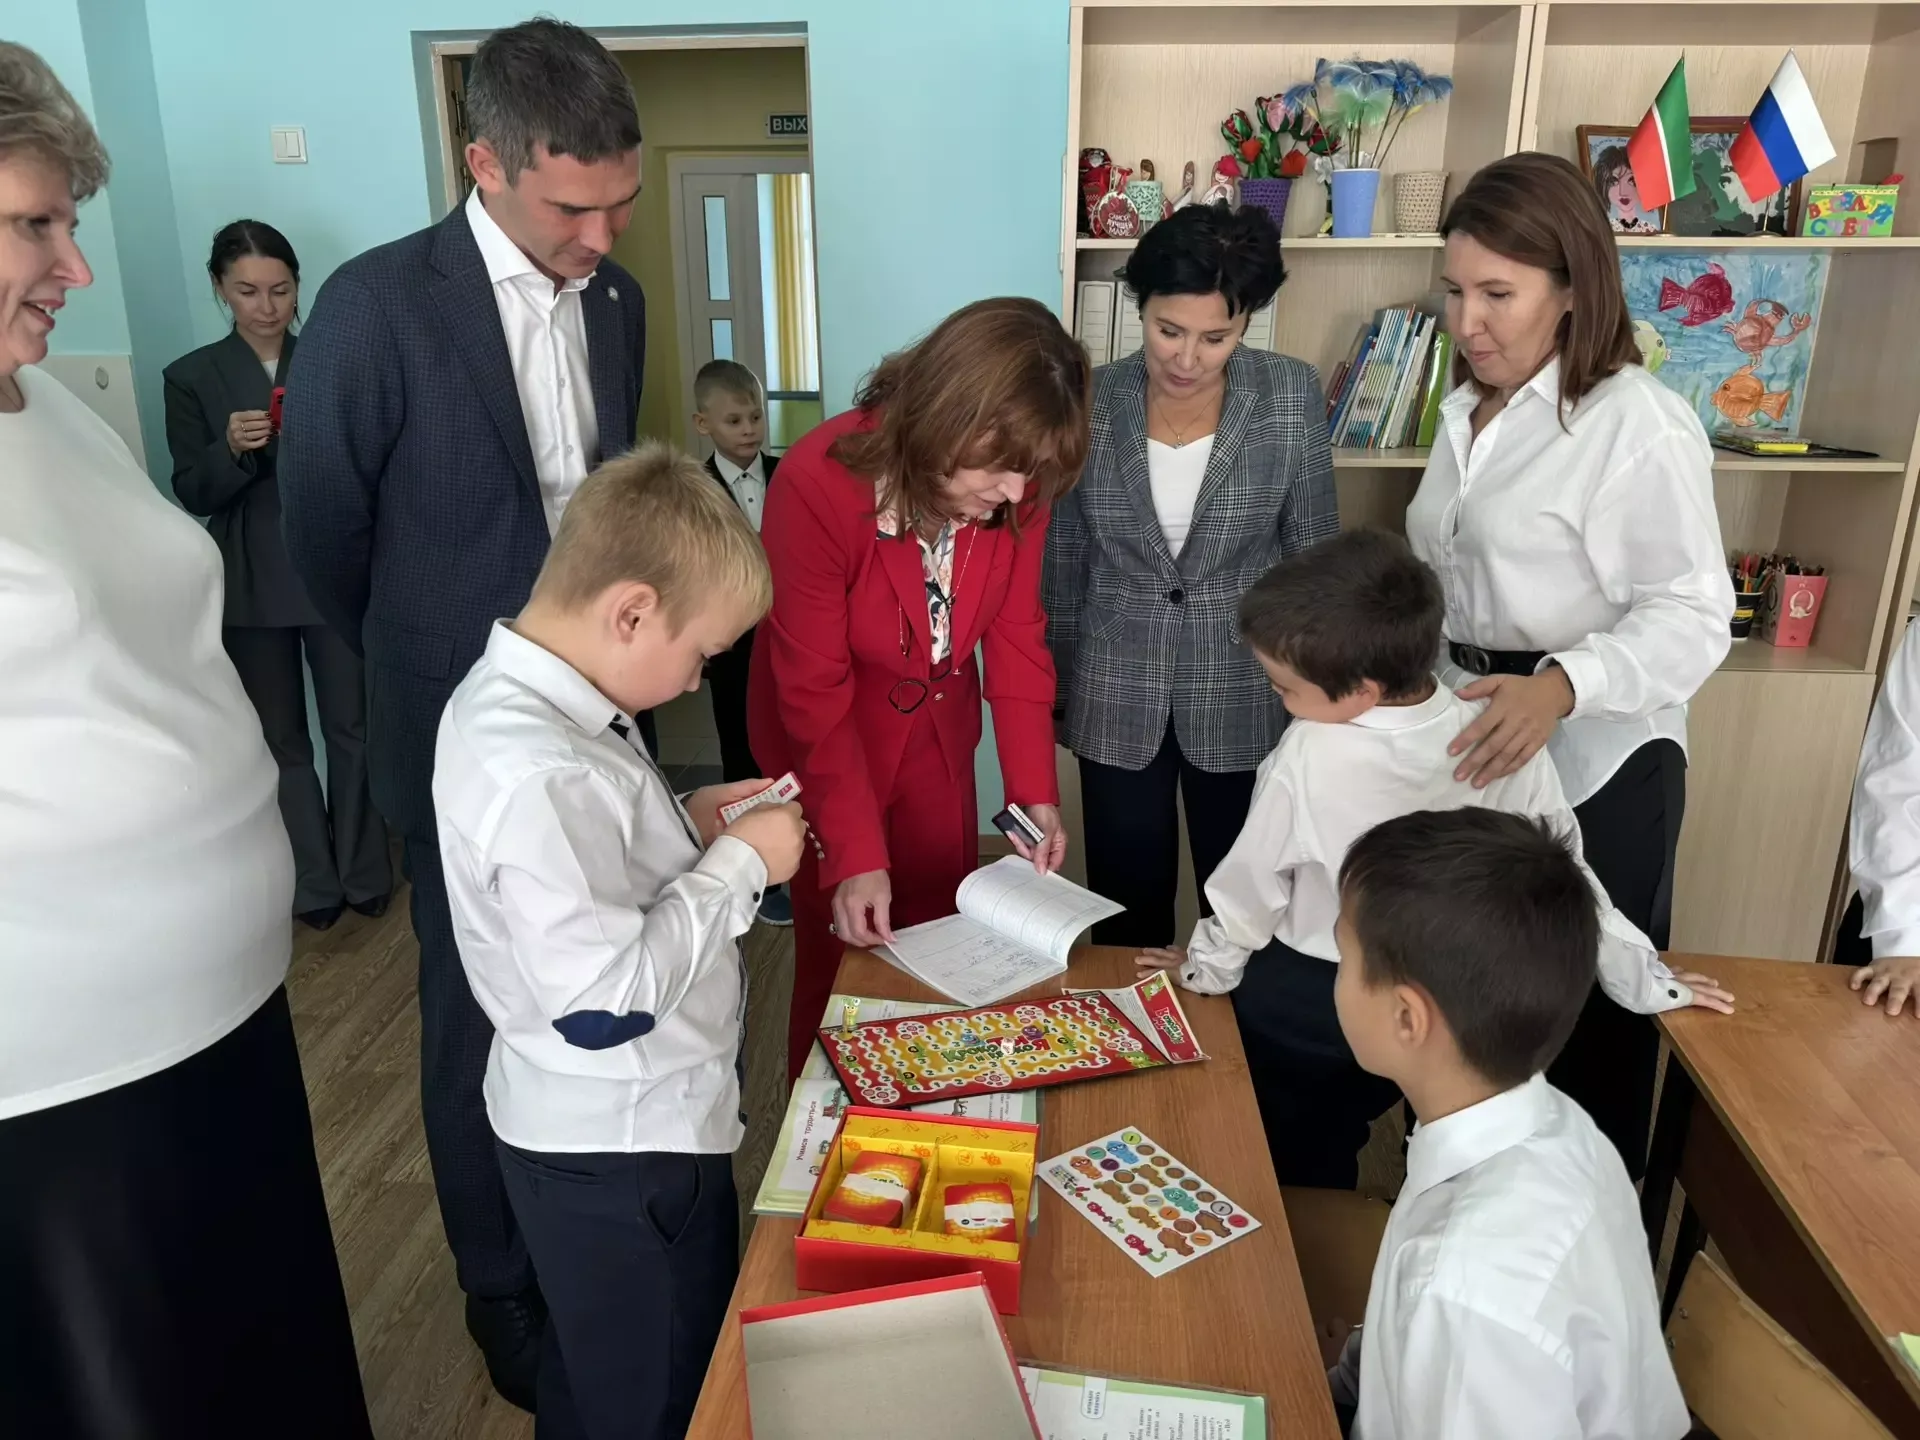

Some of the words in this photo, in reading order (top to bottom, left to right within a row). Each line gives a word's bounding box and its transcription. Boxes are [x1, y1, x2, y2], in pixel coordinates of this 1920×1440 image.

[773, 118, 807, 131] ВЫХ
[796, 1139, 808, 1161] Учимся
[804, 1101, 817, 1134] трудиться
